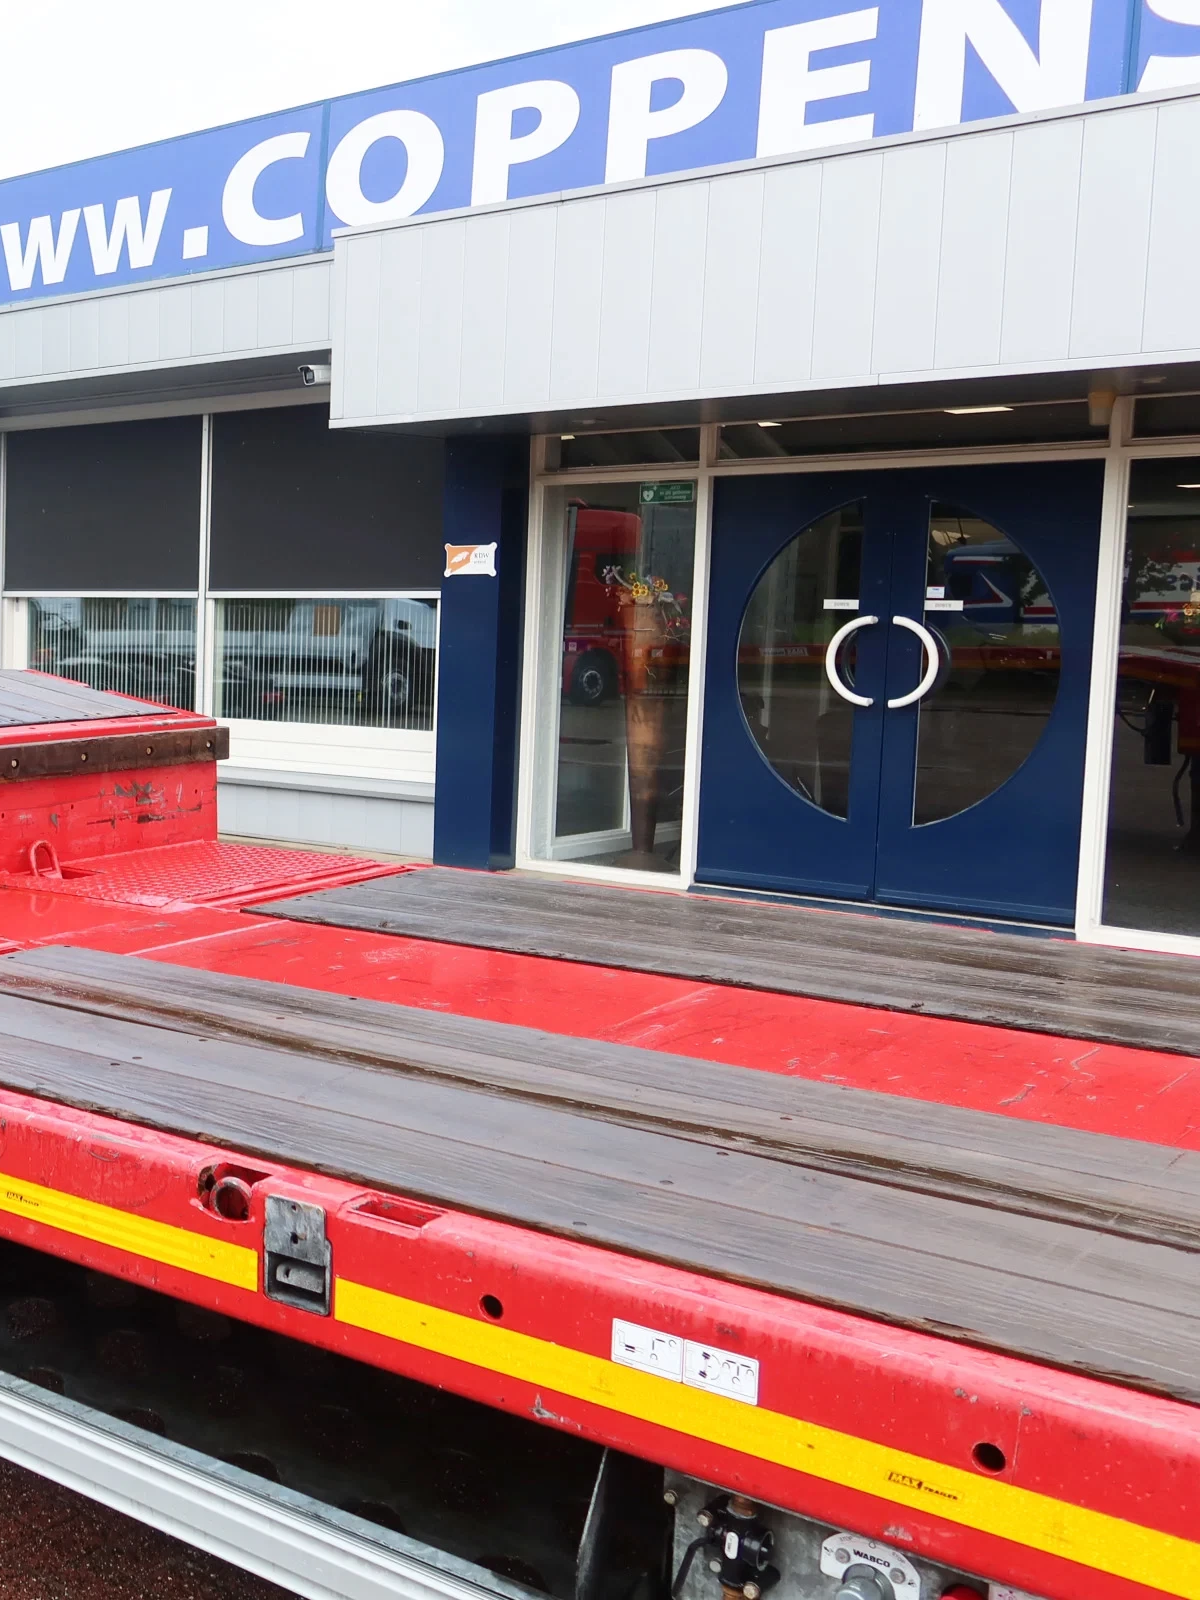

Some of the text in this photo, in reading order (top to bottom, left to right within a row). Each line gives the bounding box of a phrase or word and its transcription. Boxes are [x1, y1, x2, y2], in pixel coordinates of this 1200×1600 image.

[887, 1471, 958, 1500] MAX TRAILER
[852, 1548, 891, 1568] WABCO
